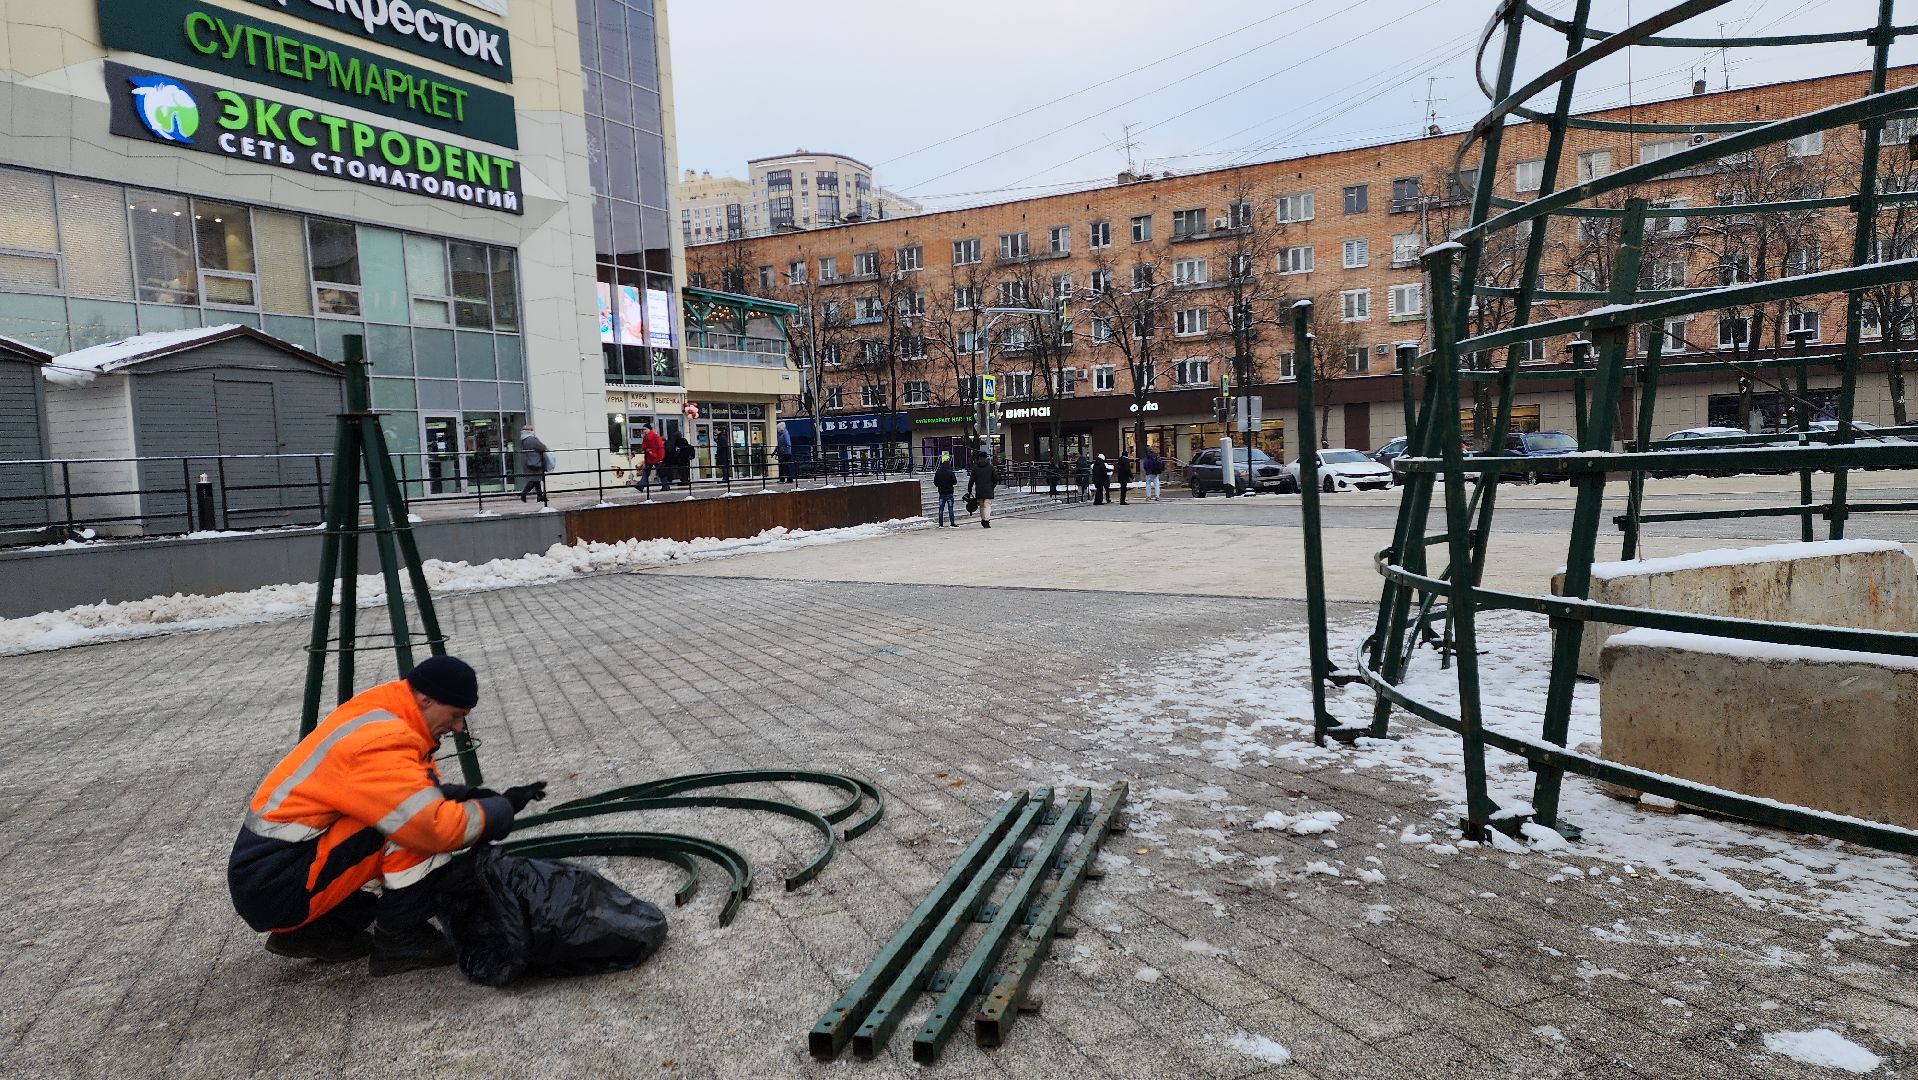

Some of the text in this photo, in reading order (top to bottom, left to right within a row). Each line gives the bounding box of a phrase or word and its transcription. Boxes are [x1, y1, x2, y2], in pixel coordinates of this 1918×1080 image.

[184, 11, 468, 122] СУПЕРМАРКЕТ
[278, 0, 502, 66] ресток
[218, 132, 518, 211] СЕТЬ СТОМАТОЛОГИЙ
